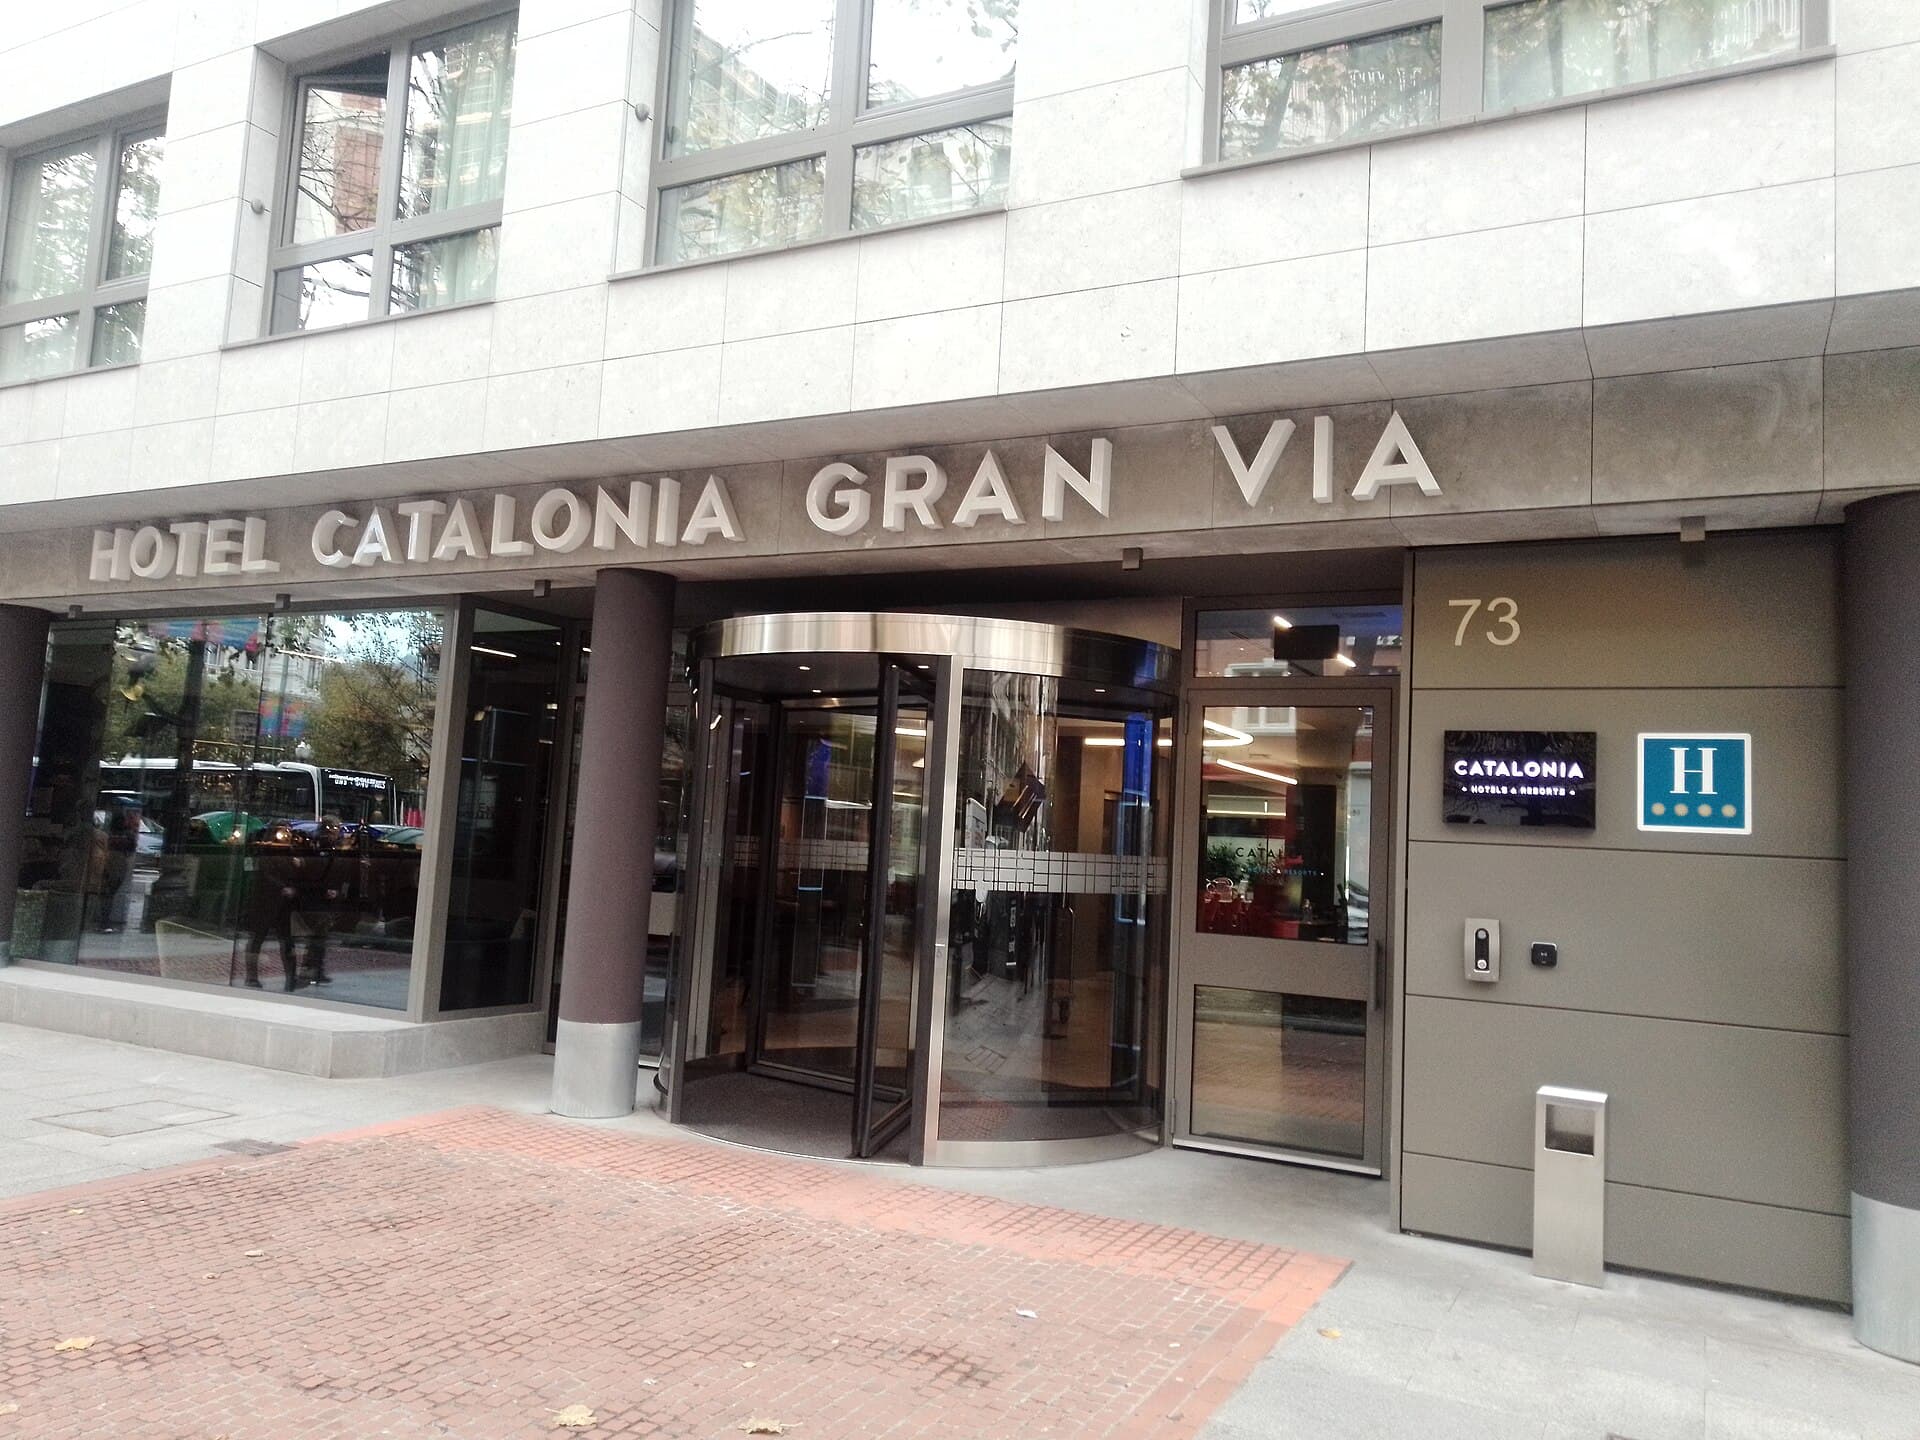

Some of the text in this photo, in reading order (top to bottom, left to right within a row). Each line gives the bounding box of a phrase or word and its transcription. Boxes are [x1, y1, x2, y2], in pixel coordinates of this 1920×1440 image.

[89, 410, 1443, 582] HOTEL CATALONIA GRAN VIA
[1448, 597, 1521, 647] 73
[1454, 760, 1584, 778] CATALONIA
[1471, 785, 1508, 795] HOTELS
[1520, 786, 1566, 796] RESORTS
[1670, 747, 1718, 795] H
